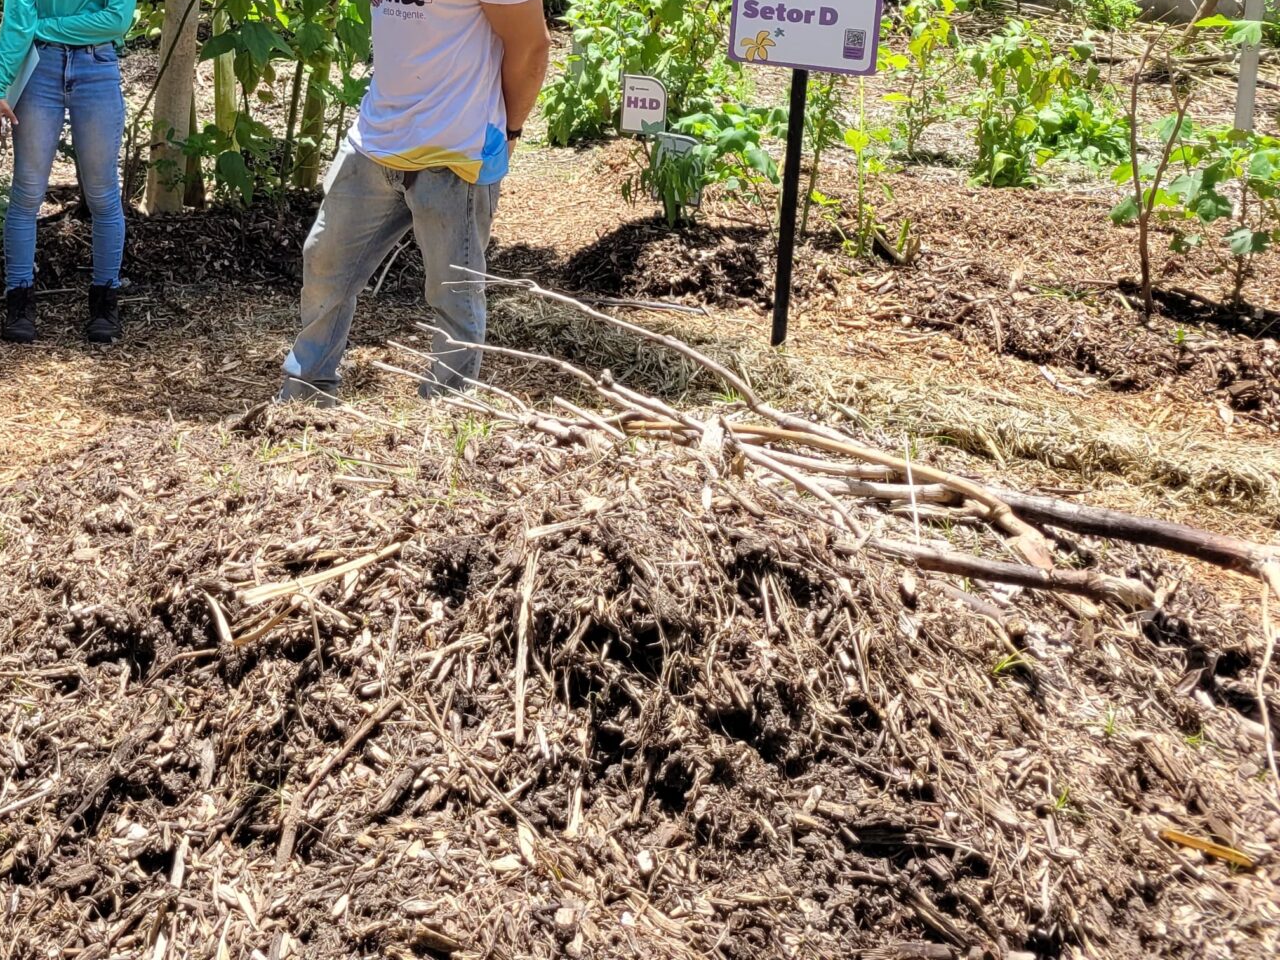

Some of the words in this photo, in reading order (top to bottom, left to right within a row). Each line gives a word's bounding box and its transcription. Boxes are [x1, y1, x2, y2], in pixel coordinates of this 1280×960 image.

[742, 0, 816, 24] Setor
[819, 6, 839, 26] D
[626, 95, 661, 110] H1D
